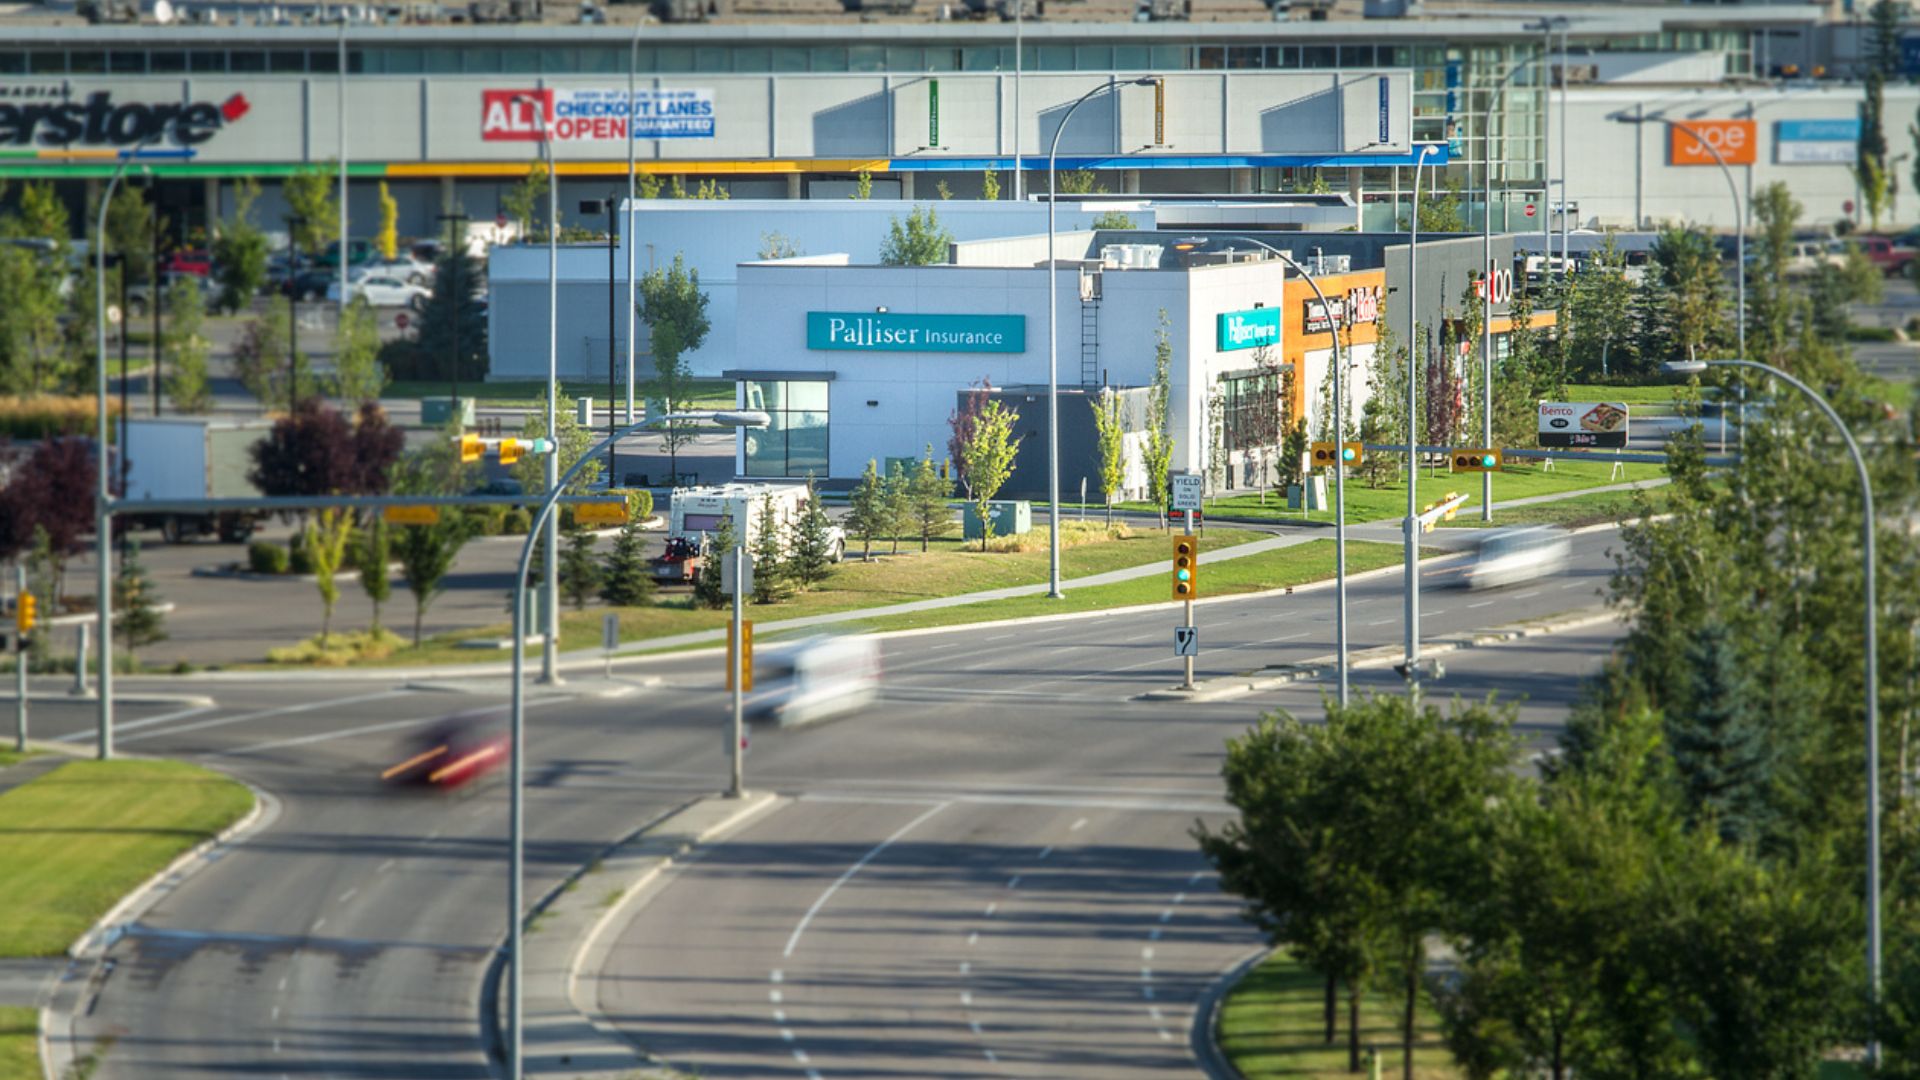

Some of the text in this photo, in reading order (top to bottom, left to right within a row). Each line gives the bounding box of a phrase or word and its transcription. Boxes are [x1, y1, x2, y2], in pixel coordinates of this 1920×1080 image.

[556, 101, 712, 116] CHECKOUT LANES
[556, 117, 626, 139] OPEN
[828, 318, 1002, 346] Palliser Insurance
